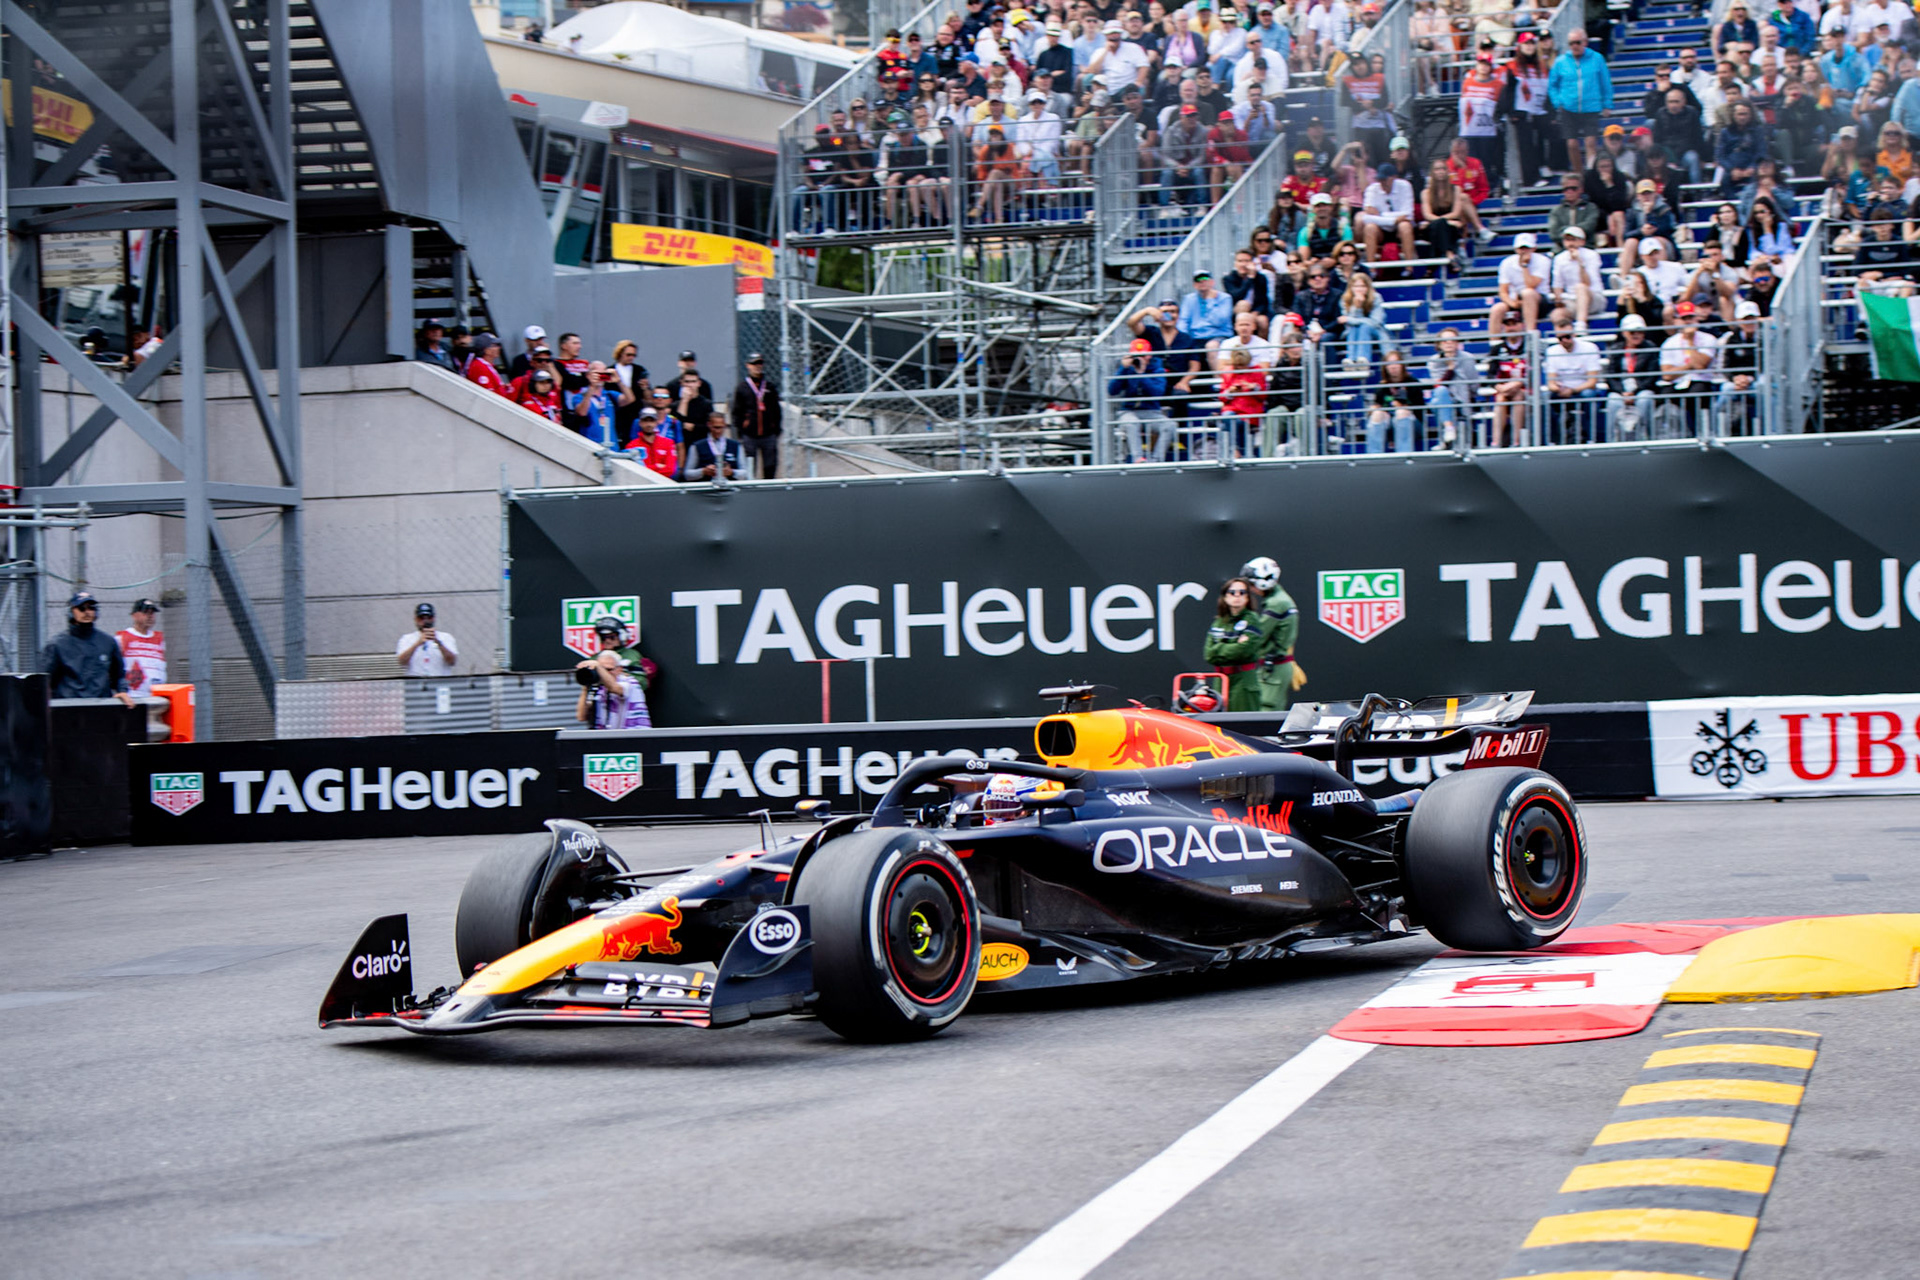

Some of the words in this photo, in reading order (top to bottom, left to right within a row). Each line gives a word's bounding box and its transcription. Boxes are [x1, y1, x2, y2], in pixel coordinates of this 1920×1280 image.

[643, 232, 698, 260] DHL
[1325, 573, 1397, 598] TAG
[569, 600, 633, 624] TAG
[1323, 601, 1400, 637] HEUER
[1468, 732, 1525, 761] Mobil
[1779, 710, 1920, 781] UB
[590, 756, 636, 772] TAG
[156, 776, 198, 789] TAG
[1107, 790, 1152, 807] ROKT
[1312, 788, 1365, 807] HONDA
[1256, 801, 1294, 834] Bull
[1093, 825, 1294, 874] ORACLE
[1231, 883, 1263, 896] SIEMENS
[352, 946, 405, 979] Claro
[979, 952, 1020, 970] AUCH
